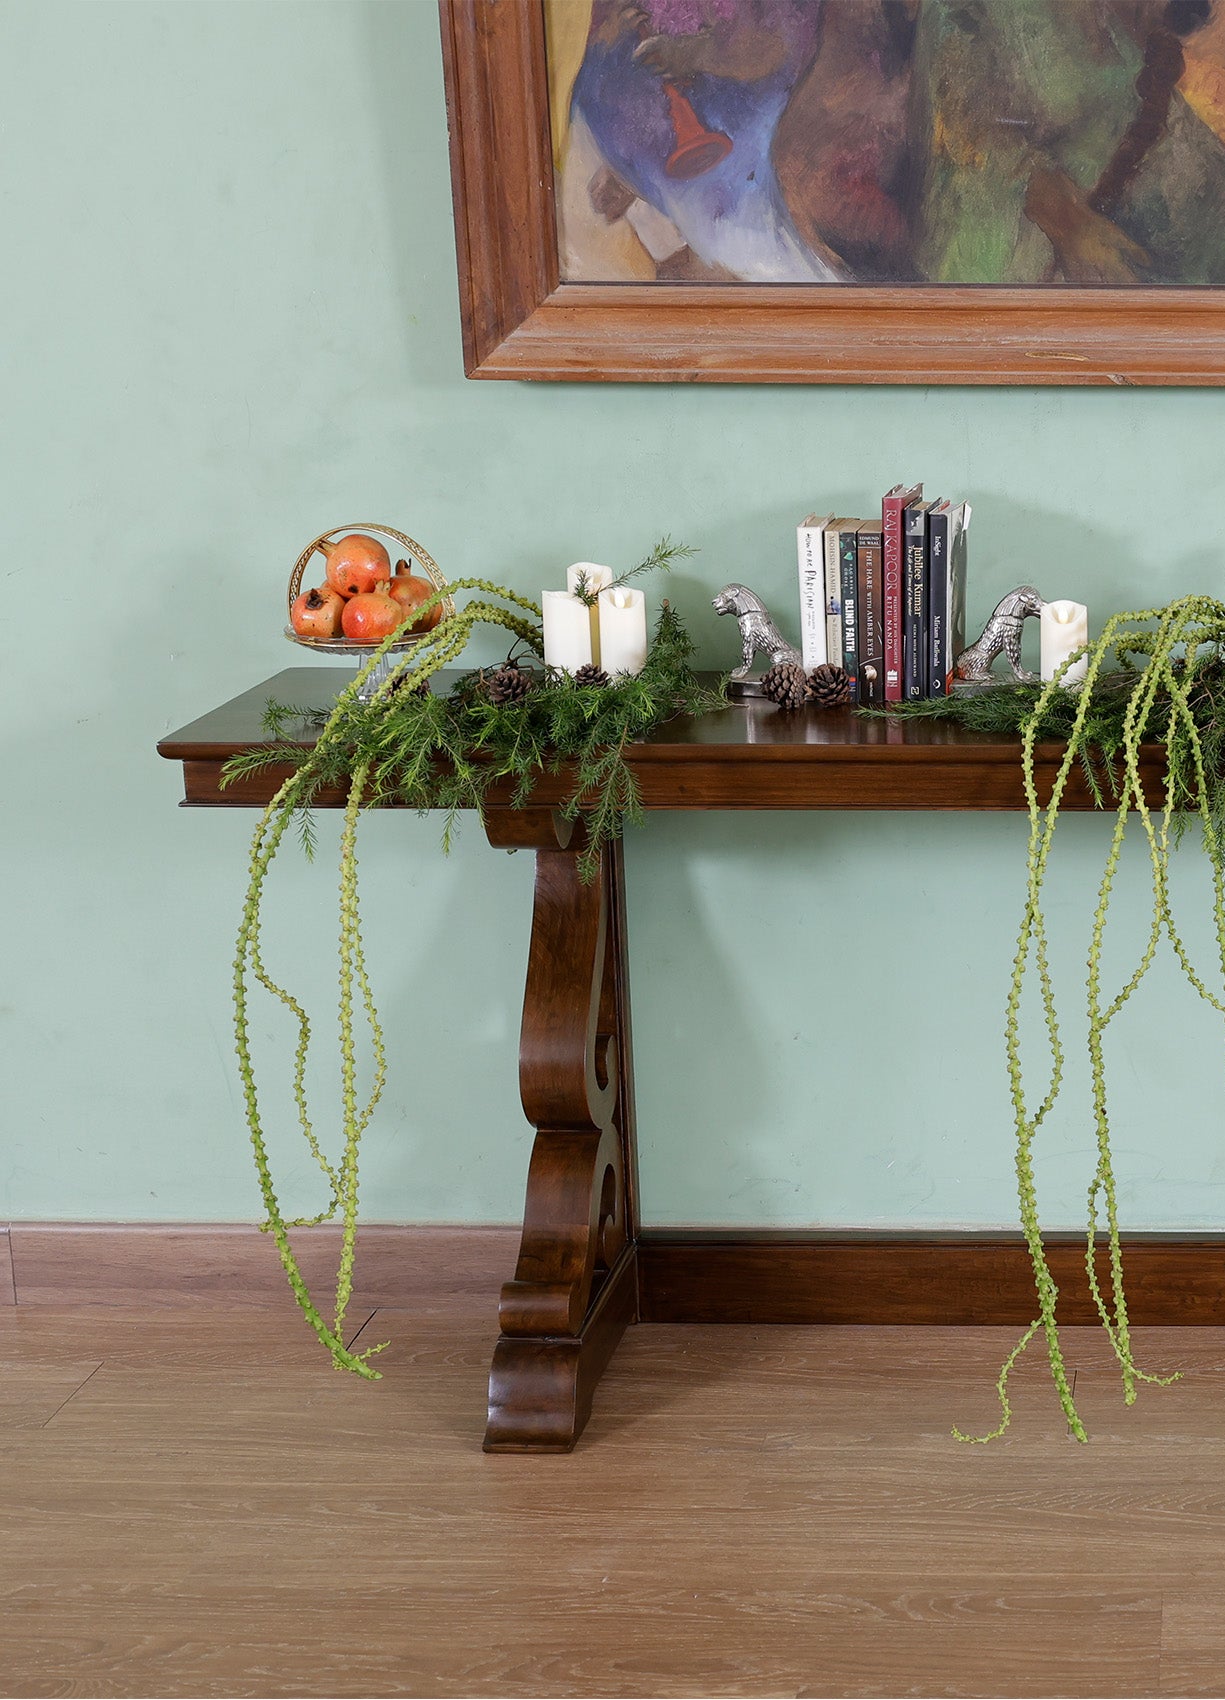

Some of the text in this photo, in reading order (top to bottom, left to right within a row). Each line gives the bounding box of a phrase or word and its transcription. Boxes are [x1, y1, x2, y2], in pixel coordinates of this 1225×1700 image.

[884, 510, 897, 591] RAJ KAPOOR
[913, 547, 923, 617] Jubilee Kumar
[845, 600, 855, 652] BLIND FAITH
